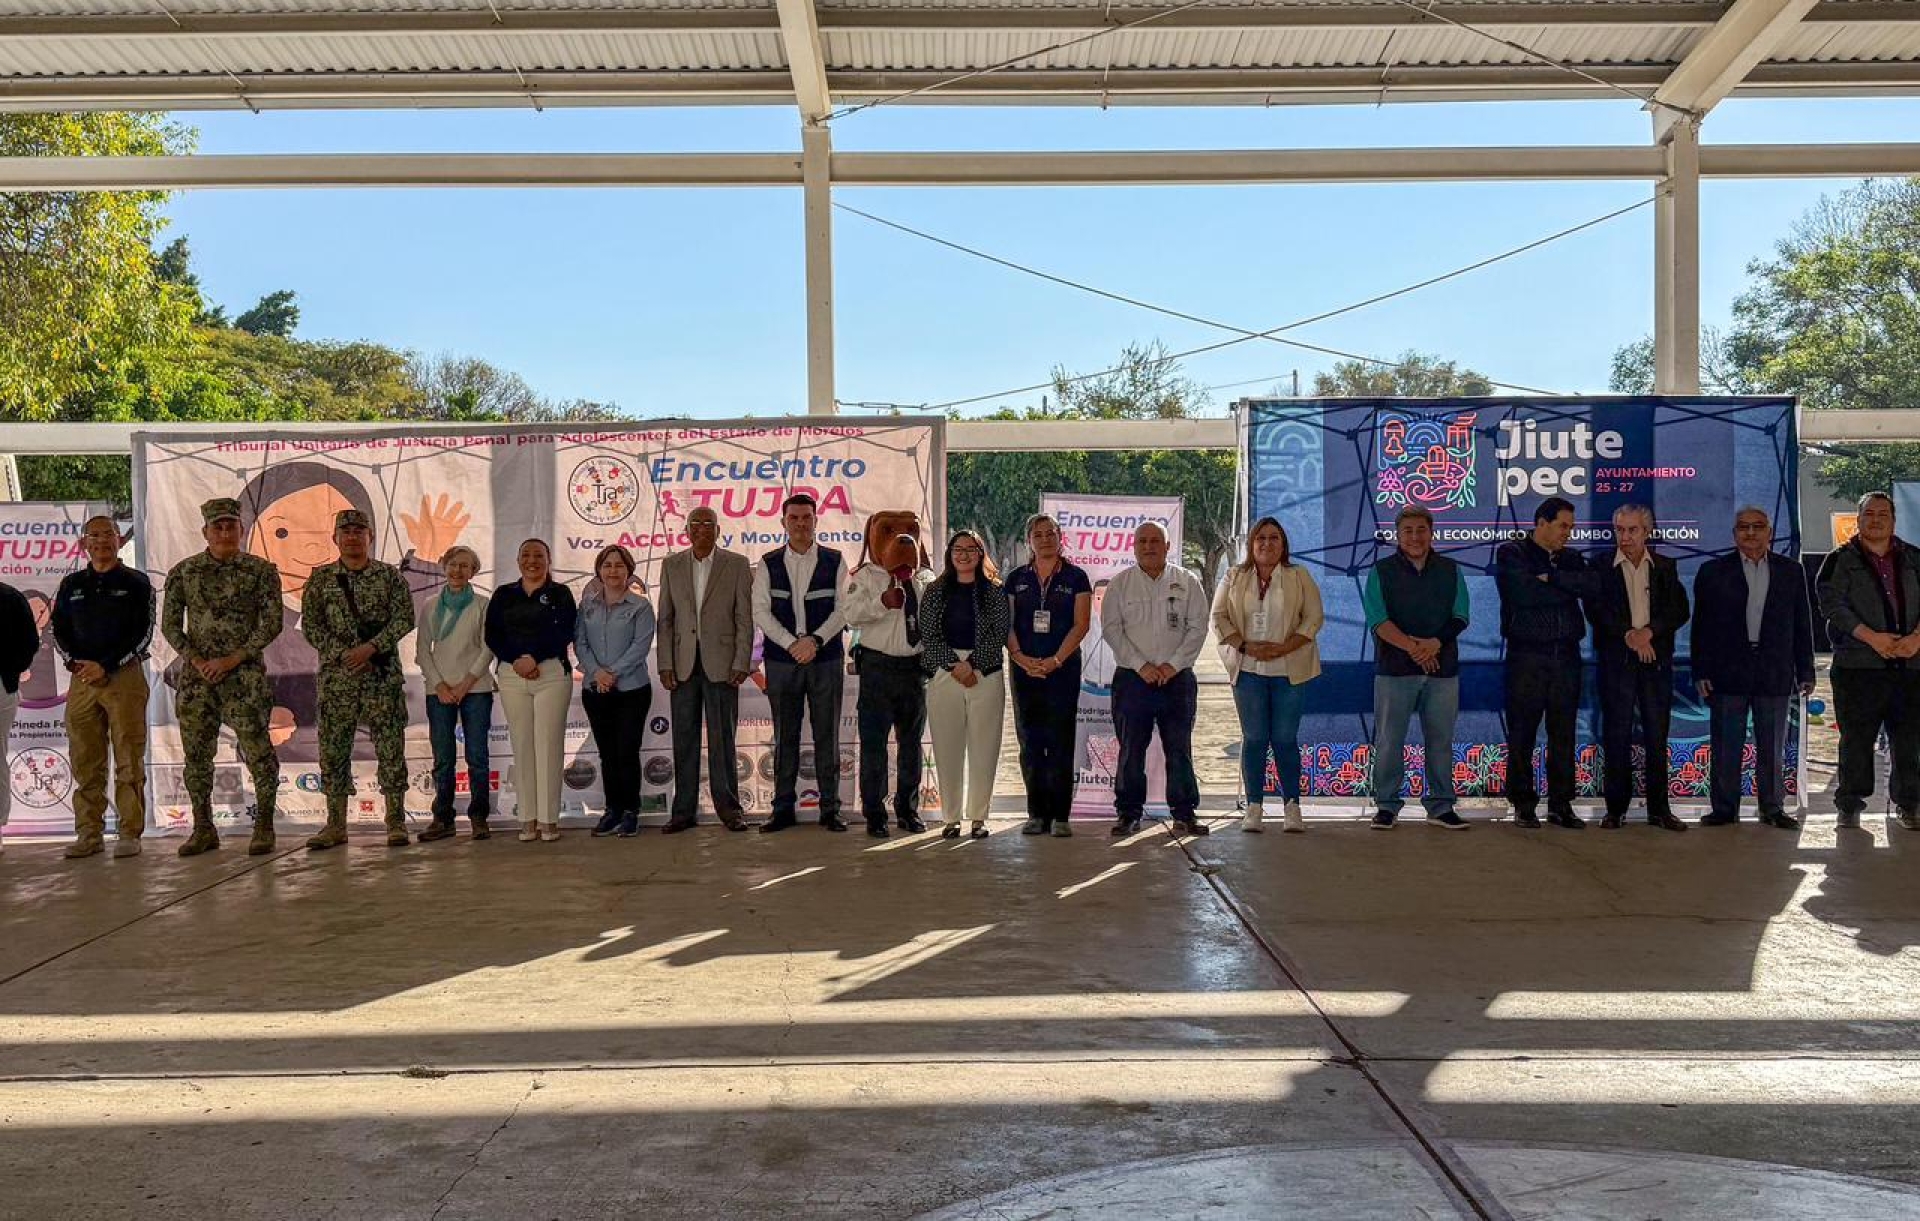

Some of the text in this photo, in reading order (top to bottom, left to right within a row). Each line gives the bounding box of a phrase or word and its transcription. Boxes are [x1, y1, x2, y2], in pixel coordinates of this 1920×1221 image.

[215, 439, 286, 452] Tribunal
[366, 437, 388, 449] de
[393, 436, 457, 448] Justicia
[464, 434, 510, 446] Penal
[516, 435, 554, 447] para
[560, 430, 670, 444] Adolescentes
[678, 428, 703, 439] del
[710, 427, 766, 439] Estado
[773, 426, 793, 437] de
[799, 425, 864, 437] Morelos
[1495, 418, 1624, 459] Jiute
[651, 455, 866, 483] Encuentro
[1595, 467, 1696, 478] AYUNTAMIENTO
[1497, 466, 1586, 506] pec
[1595, 482, 1611, 493] 25
[1619, 482, 1635, 493] 27
[0, 520, 81, 535] cuentr
[1444, 527, 1527, 541] ECONÓMICO
[1567, 529, 1612, 540] UMBO
[1649, 525, 1699, 540] DICIÓN
[618, 528, 692, 548] Acció
[722, 532, 733, 547] y
[1076, 532, 1135, 552] TUJP
[0, 563, 32, 574] ción
[35, 567, 42, 576] y
[11, 720, 50, 729] Pineda
[1073, 772, 1116, 788] Jiutep
